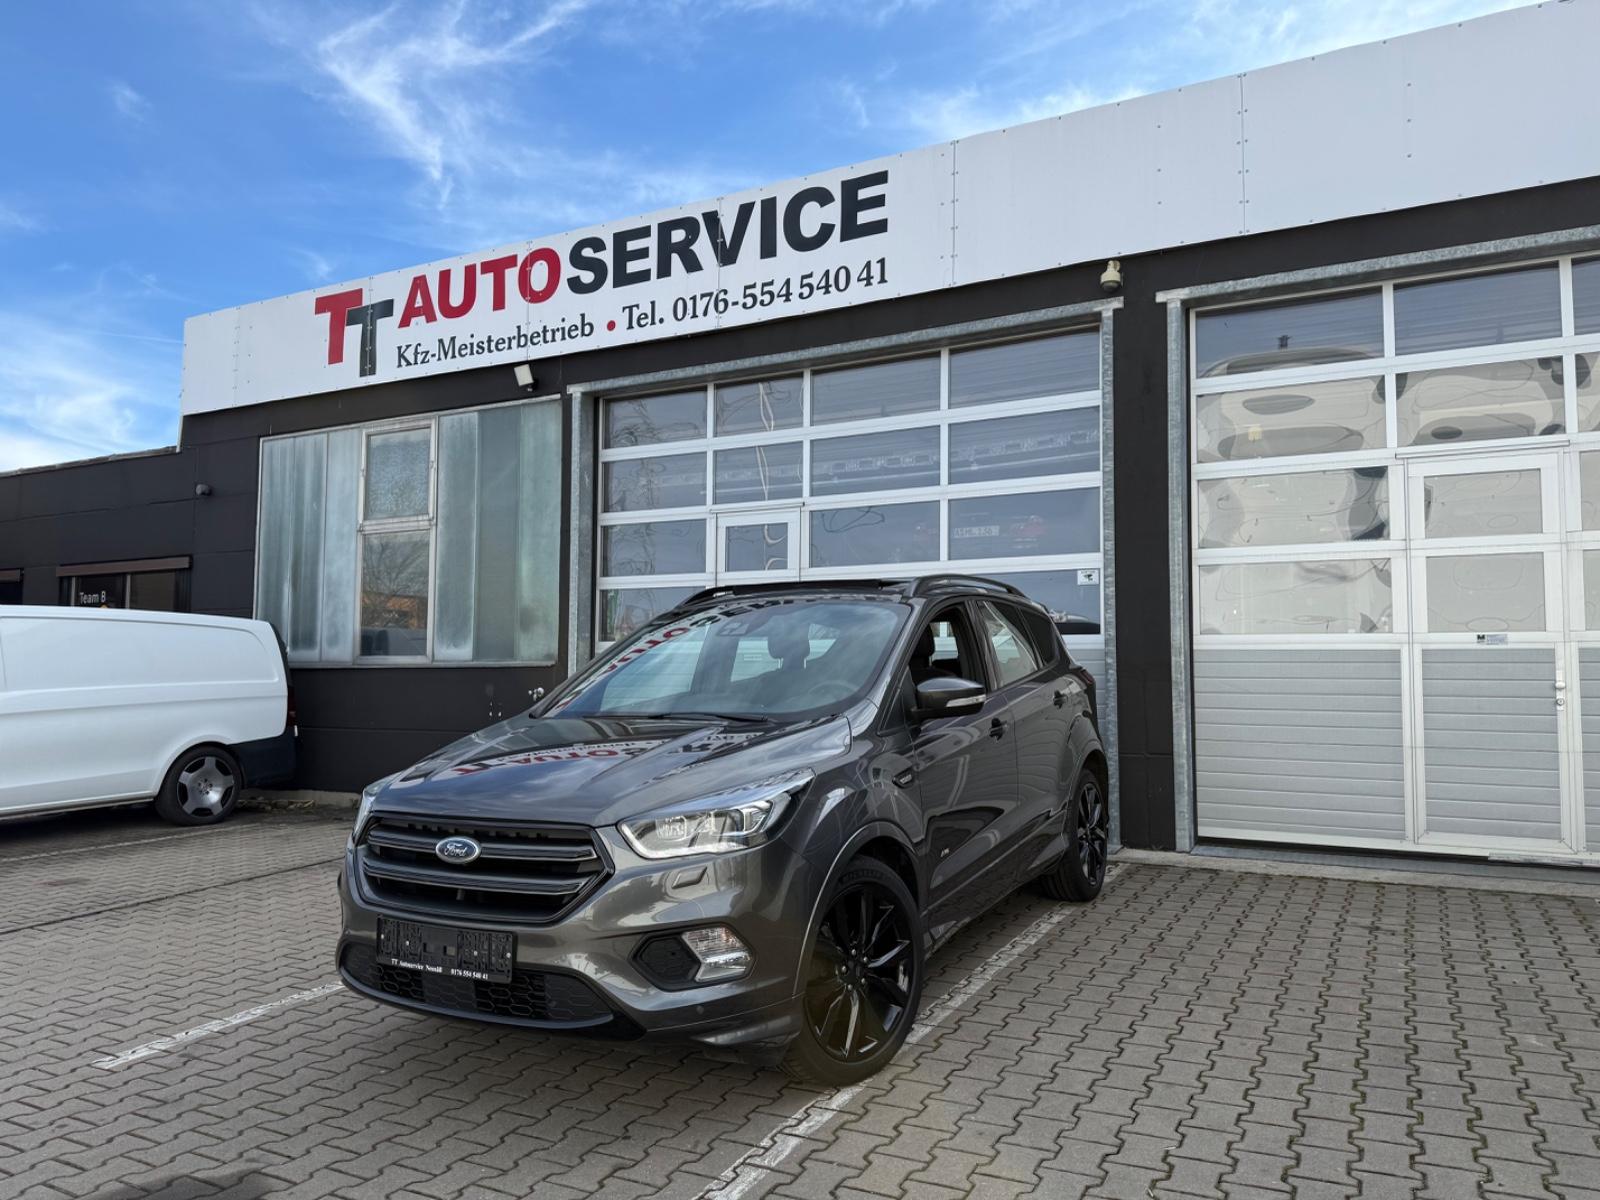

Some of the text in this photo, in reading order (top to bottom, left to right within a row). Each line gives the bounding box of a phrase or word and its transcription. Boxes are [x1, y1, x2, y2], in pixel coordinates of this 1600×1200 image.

[396, 313, 594, 369] Kfz-Meisterbetrieb
[622, 303, 665, 330] Tel.
[79, 591, 99, 604] Team
[444, 841, 468, 857] Ford
